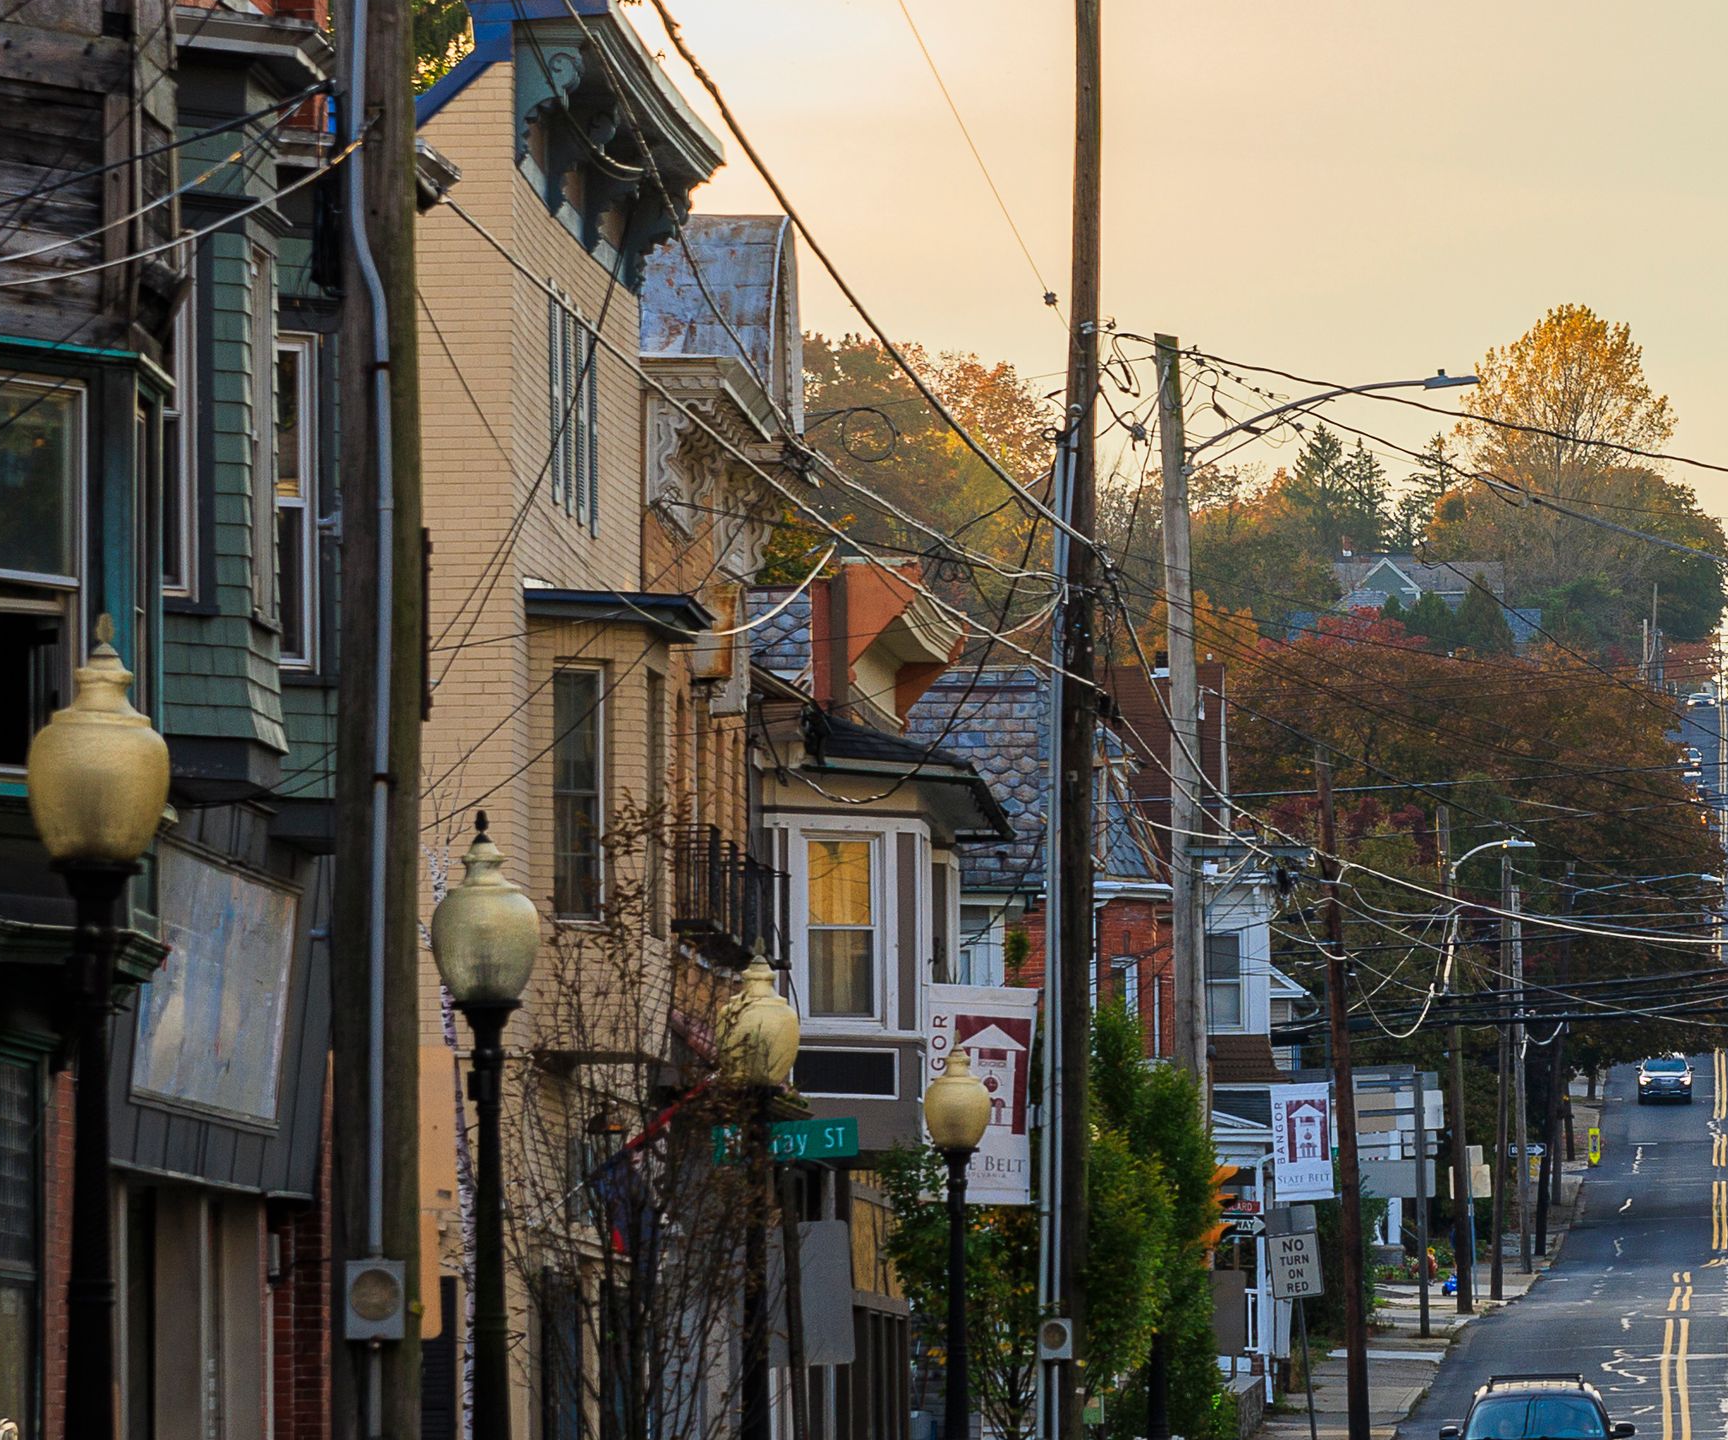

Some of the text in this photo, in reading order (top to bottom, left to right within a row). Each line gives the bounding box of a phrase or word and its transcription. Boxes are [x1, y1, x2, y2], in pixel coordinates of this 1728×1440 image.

[824, 1127, 845, 1148] ST
[1274, 1102, 1286, 1165] BANGOR
[985, 1156, 1026, 1173] BELT
[1282, 1239, 1304, 1253] NO
[1279, 1254, 1309, 1267] TURN
[1288, 1268, 1304, 1279] ON
[1286, 1281, 1309, 1293] RED
